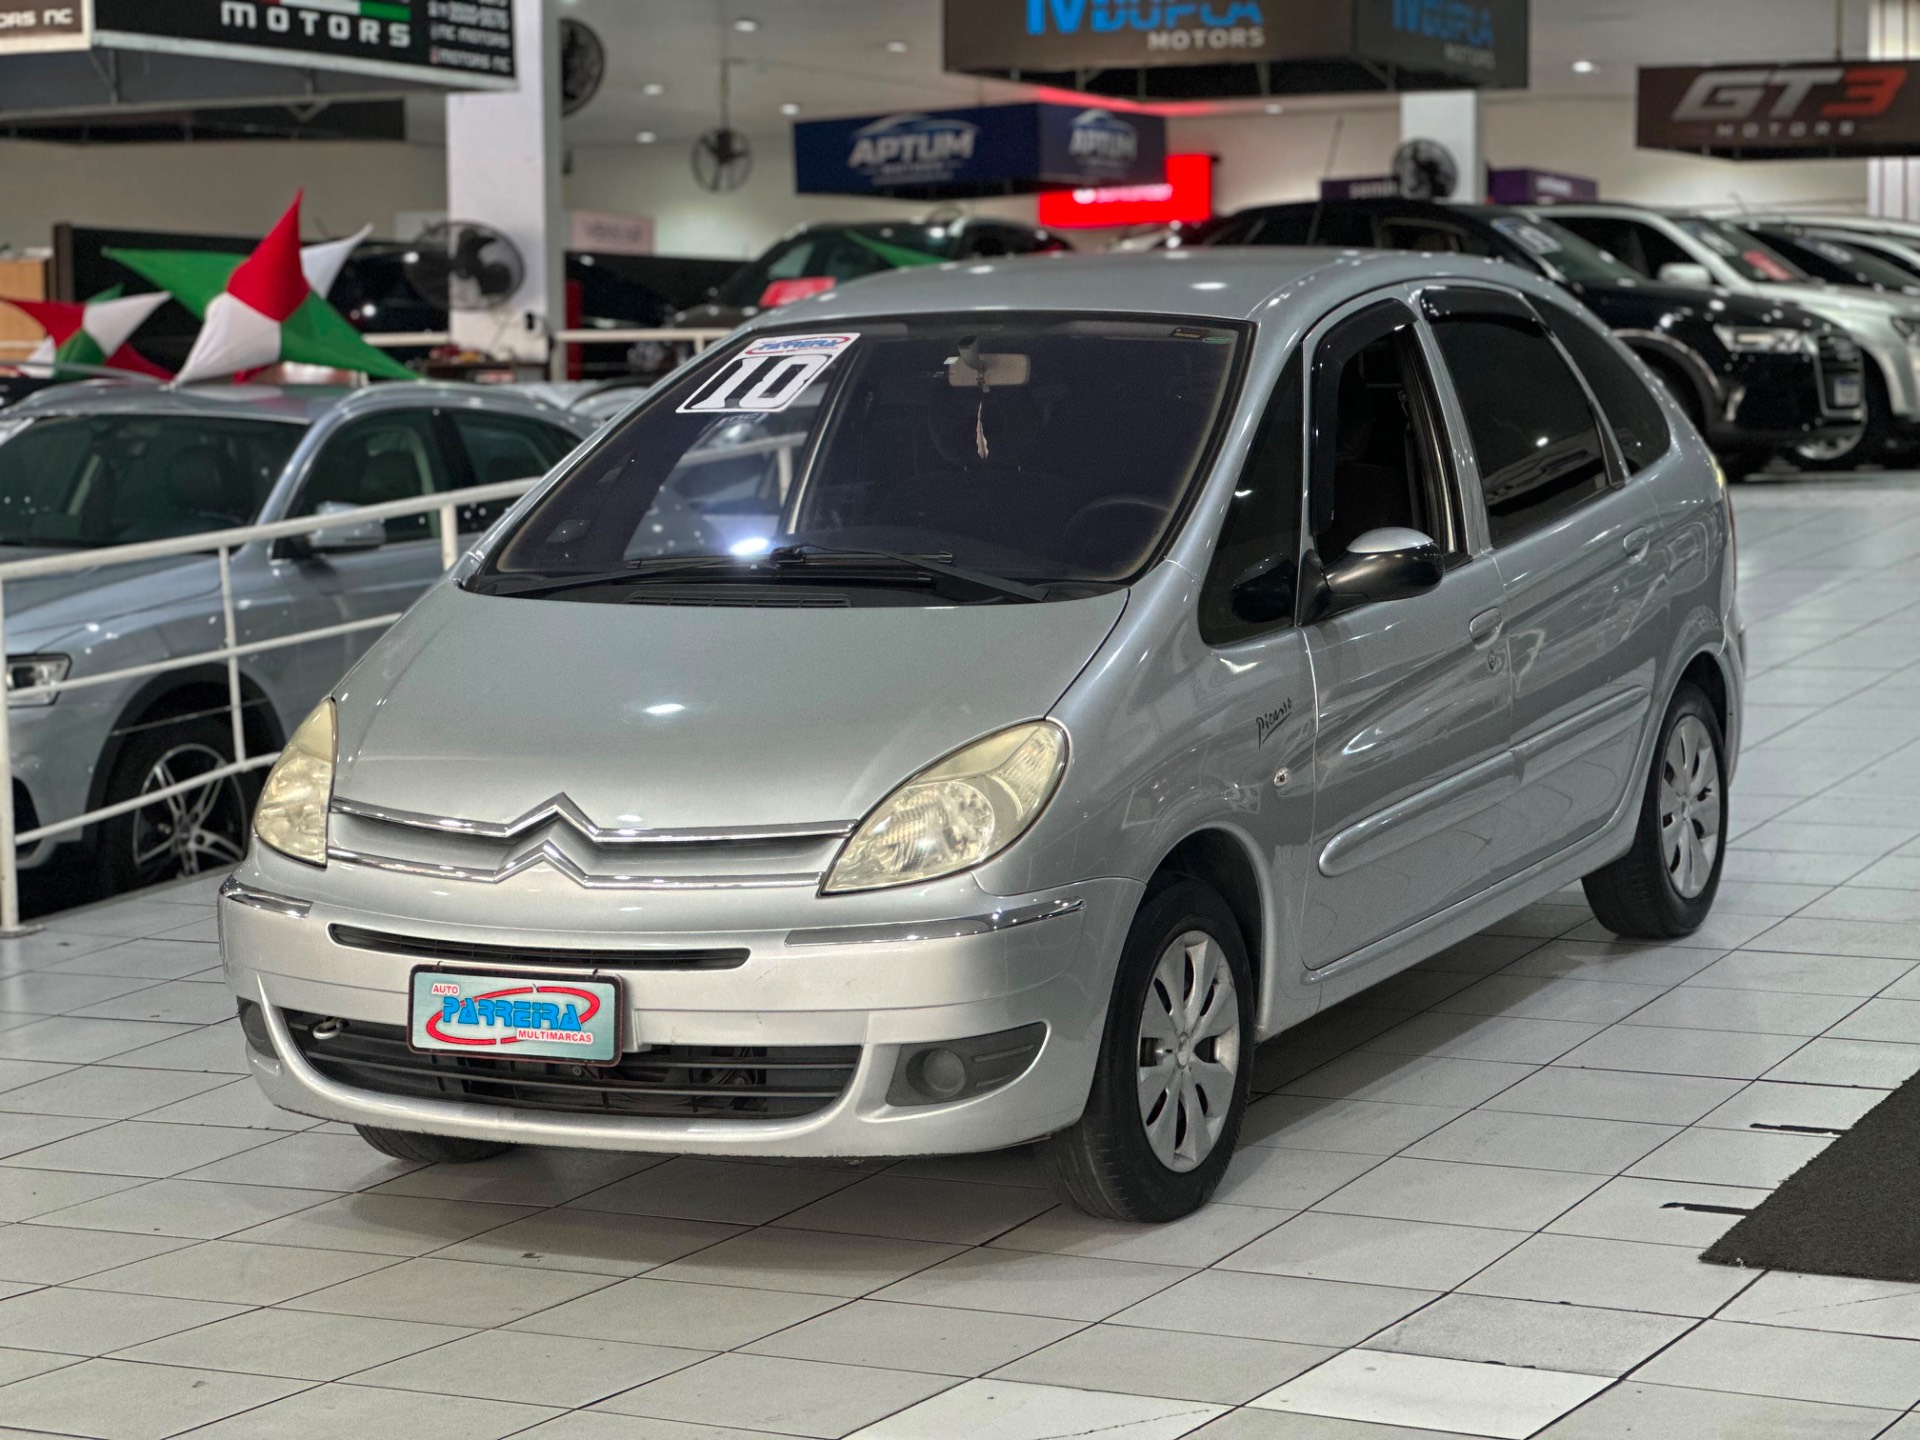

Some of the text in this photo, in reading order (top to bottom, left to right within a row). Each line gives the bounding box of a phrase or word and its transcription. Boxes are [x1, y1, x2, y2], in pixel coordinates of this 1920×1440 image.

[1147, 27, 1265, 50] MOTORS
[1672, 67, 1908, 121] GT3
[1715, 119, 1856, 137] MOTORS
[848, 128, 976, 168] APTUM
[690, 353, 832, 409] 10
[1256, 697, 1292, 751] Picasso
[432, 984, 459, 995] AUTO
[442, 996, 582, 1031] PARREIRA
[518, 1030, 592, 1043] MULTIMARCAS
